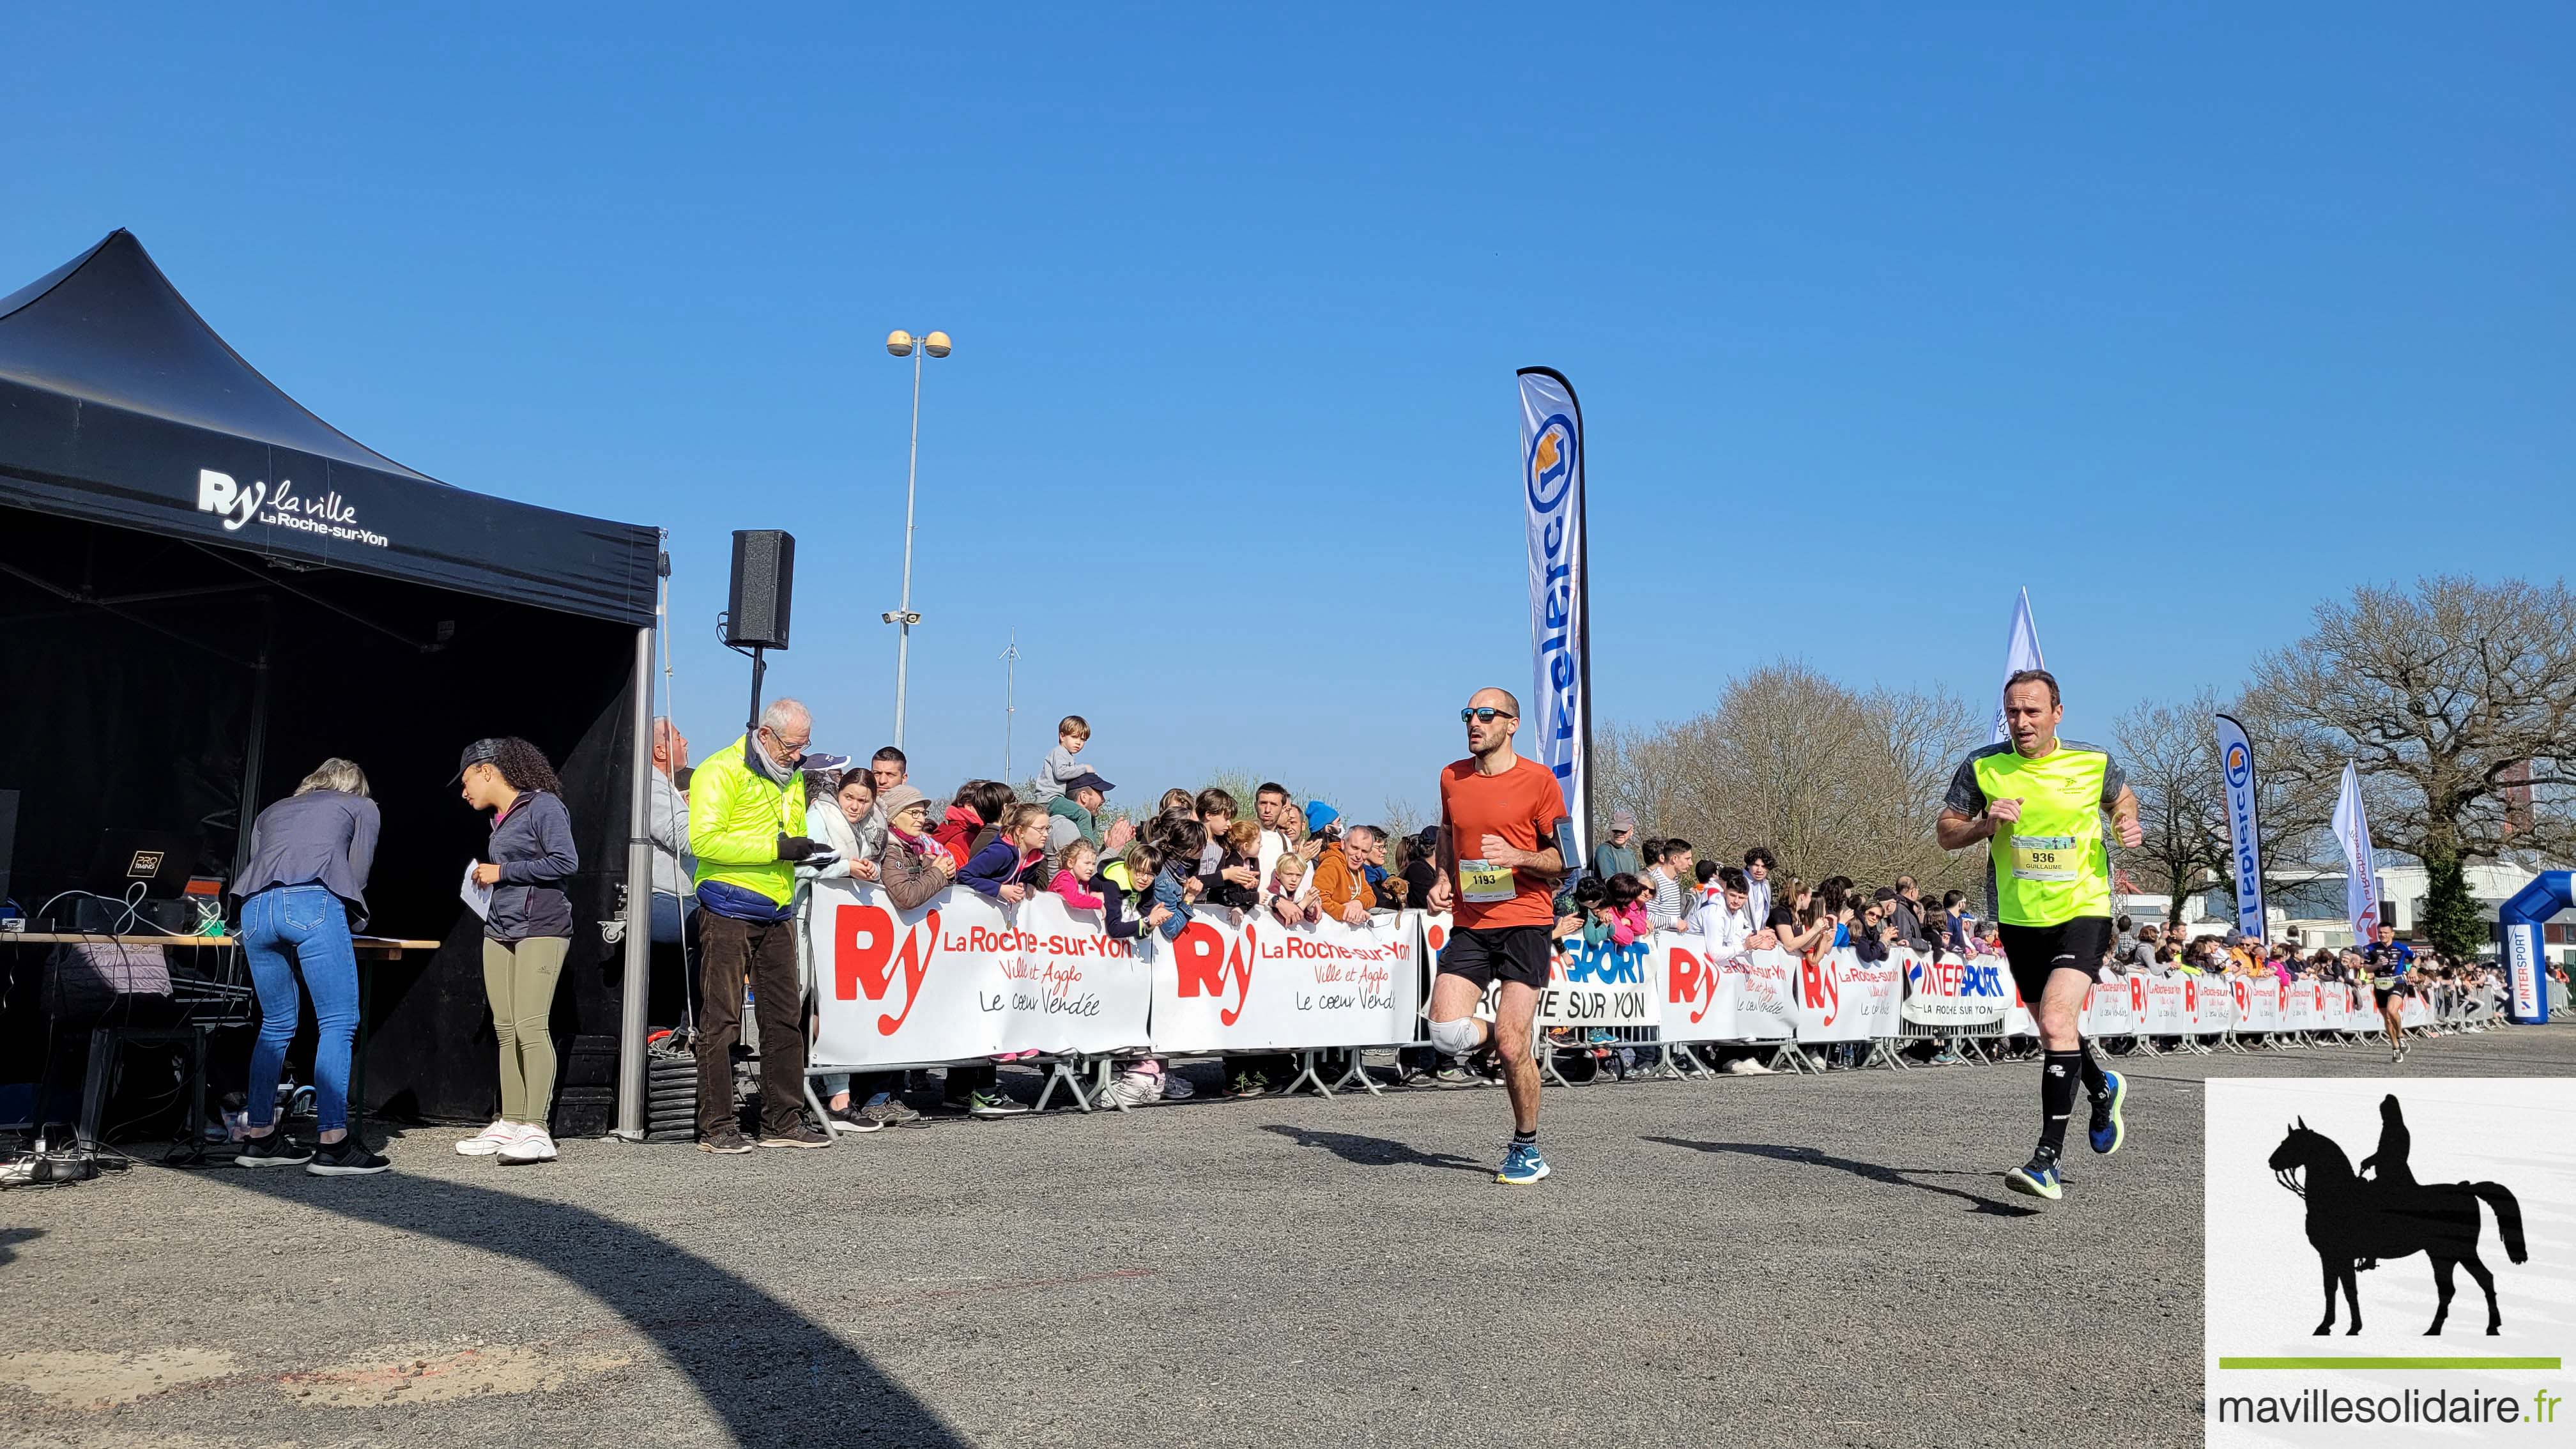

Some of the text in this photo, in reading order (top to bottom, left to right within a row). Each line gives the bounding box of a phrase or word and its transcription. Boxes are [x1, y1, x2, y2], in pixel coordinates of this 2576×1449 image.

[267, 480, 356, 523] la ville
[278, 512, 388, 547] Roche-sur-Yon
[2032, 852, 2055, 862] 936
[1473, 875, 1496, 885] 1193
[944, 926, 1132, 959] La Roche-sur-Yon
[1262, 937, 1410, 962] La Roche-sur-Yon
[999, 957, 1082, 997] Ville et Agglo
[1315, 963, 1389, 995] Ville et Agglo
[1922, 961, 2004, 997] INTERSPORT
[2514, 933, 2530, 999] INTERSPORT
[979, 990, 1004, 1012] Le
[1042, 986, 1101, 1017] Vendée
[1296, 991, 1312, 1011] Le
[1567, 991, 1606, 1018] SUR
[1614, 992, 1645, 1018] YON
[1924, 1005, 1993, 1015] LA ROCHE SUR YON
